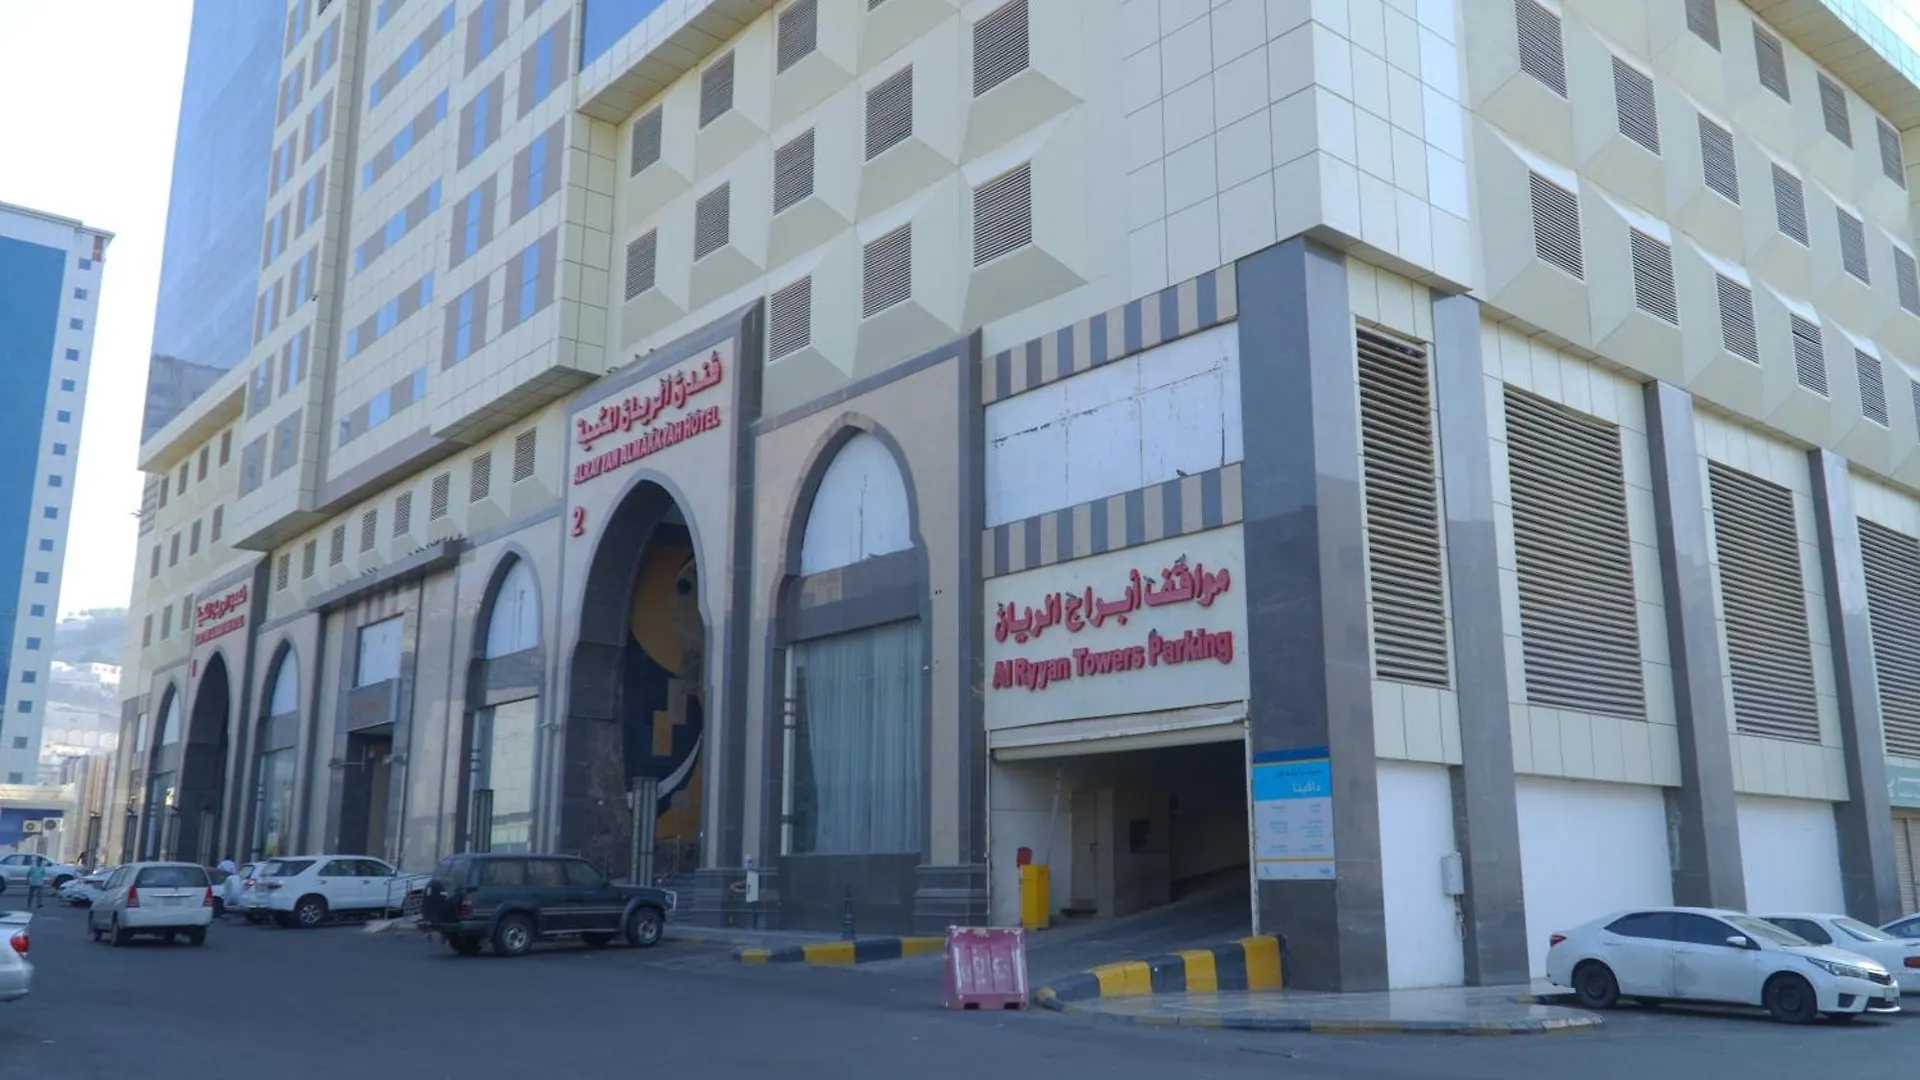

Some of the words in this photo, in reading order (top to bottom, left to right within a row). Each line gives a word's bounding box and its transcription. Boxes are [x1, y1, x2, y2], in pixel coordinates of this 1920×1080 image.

[684, 406, 721, 441] HOTEL
[571, 506, 585, 538] 2
[1065, 568, 1141, 632] أبراج
[1143, 562, 1231, 607] مواقف
[994, 592, 1062, 644] الريان
[993, 660, 1013, 690] Al
[1014, 656, 1071, 691] Ryyan
[1073, 646, 1145, 677] Towers
[1147, 629, 1233, 665] Parking
